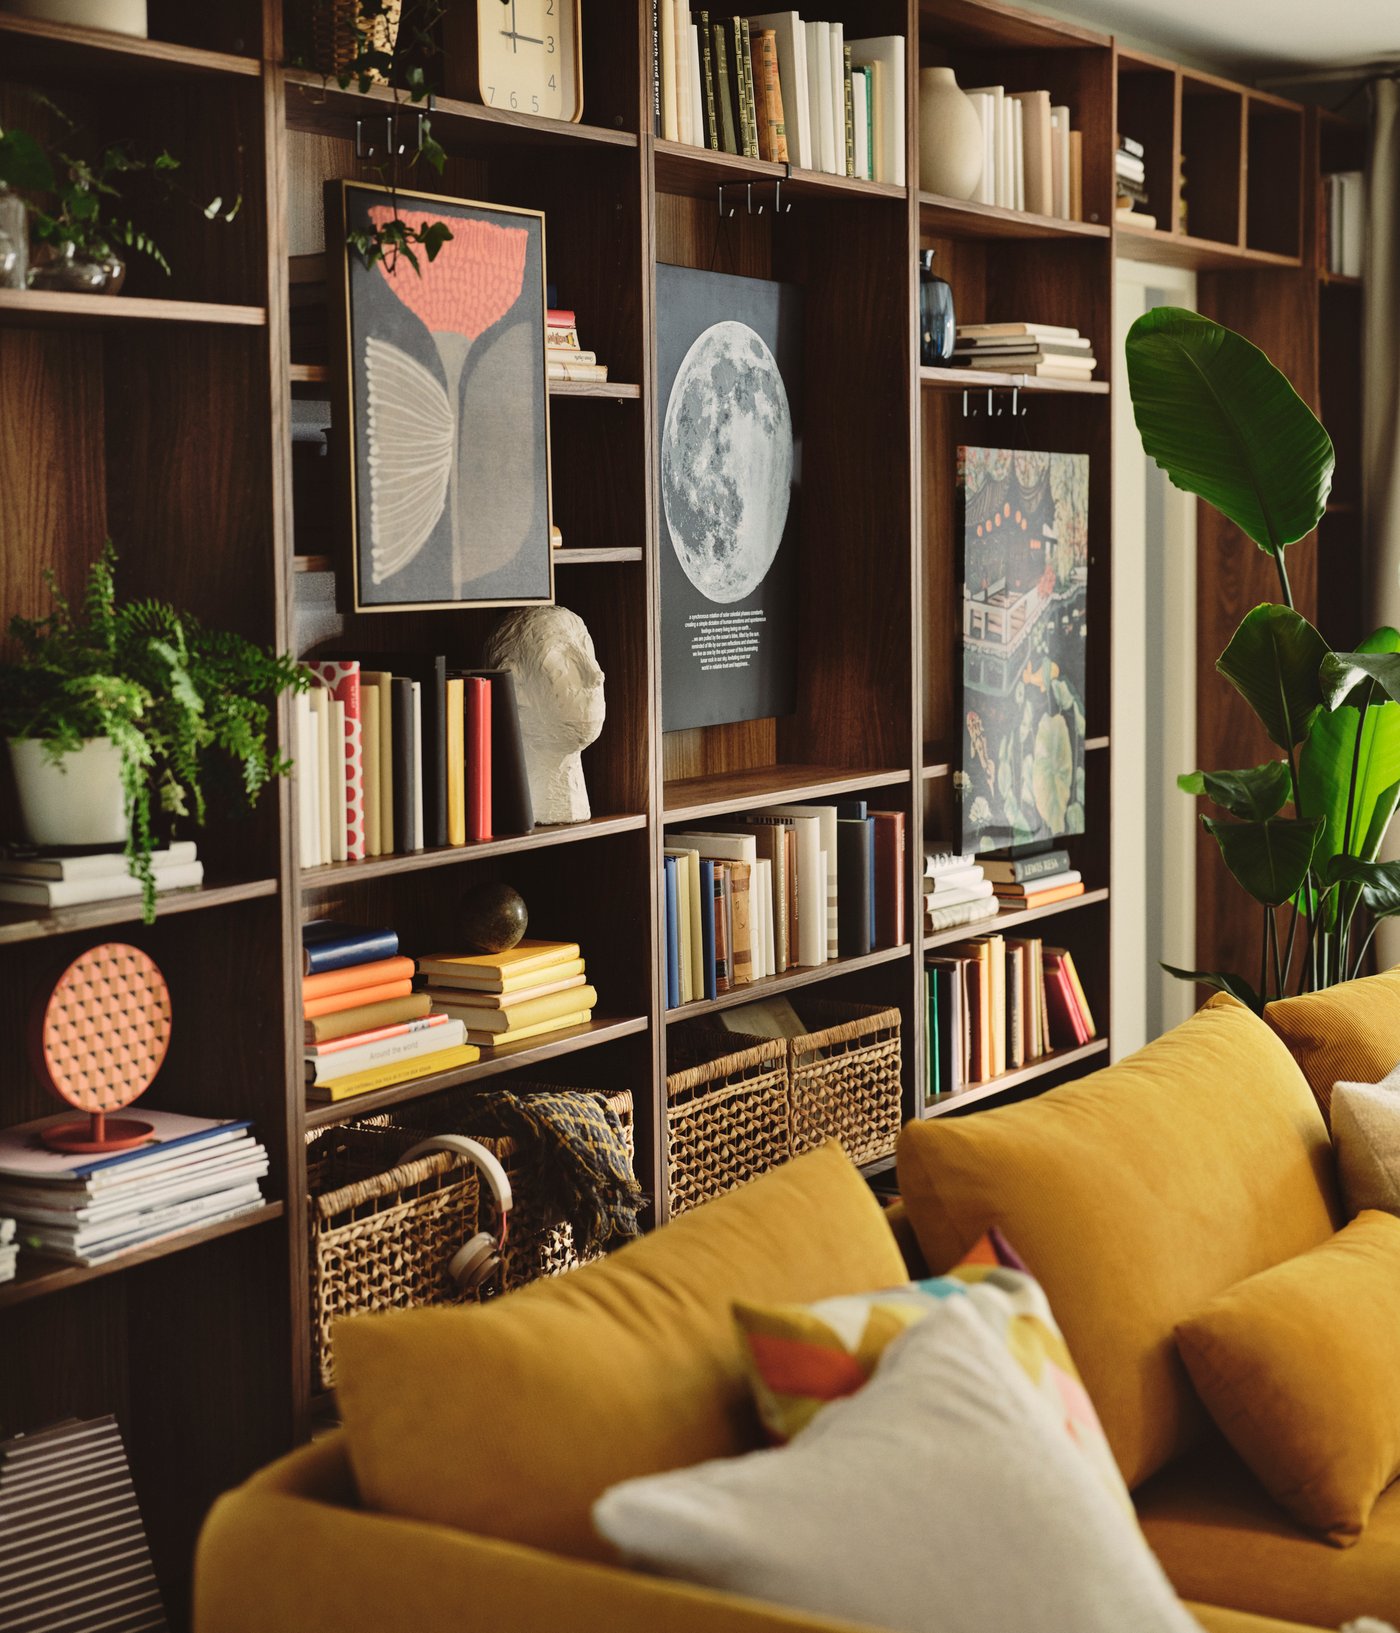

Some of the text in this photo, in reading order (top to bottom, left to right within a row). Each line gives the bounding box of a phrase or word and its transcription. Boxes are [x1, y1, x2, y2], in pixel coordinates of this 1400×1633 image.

[546, 0, 554, 16] 2
[546, 35, 555, 54] 3
[547, 74, 557, 91] 4
[487, 86, 496, 104] 7
[509, 91, 518, 109] 6
[531, 95, 540, 113] 5
[369, 1041, 419, 1061] Around the world
